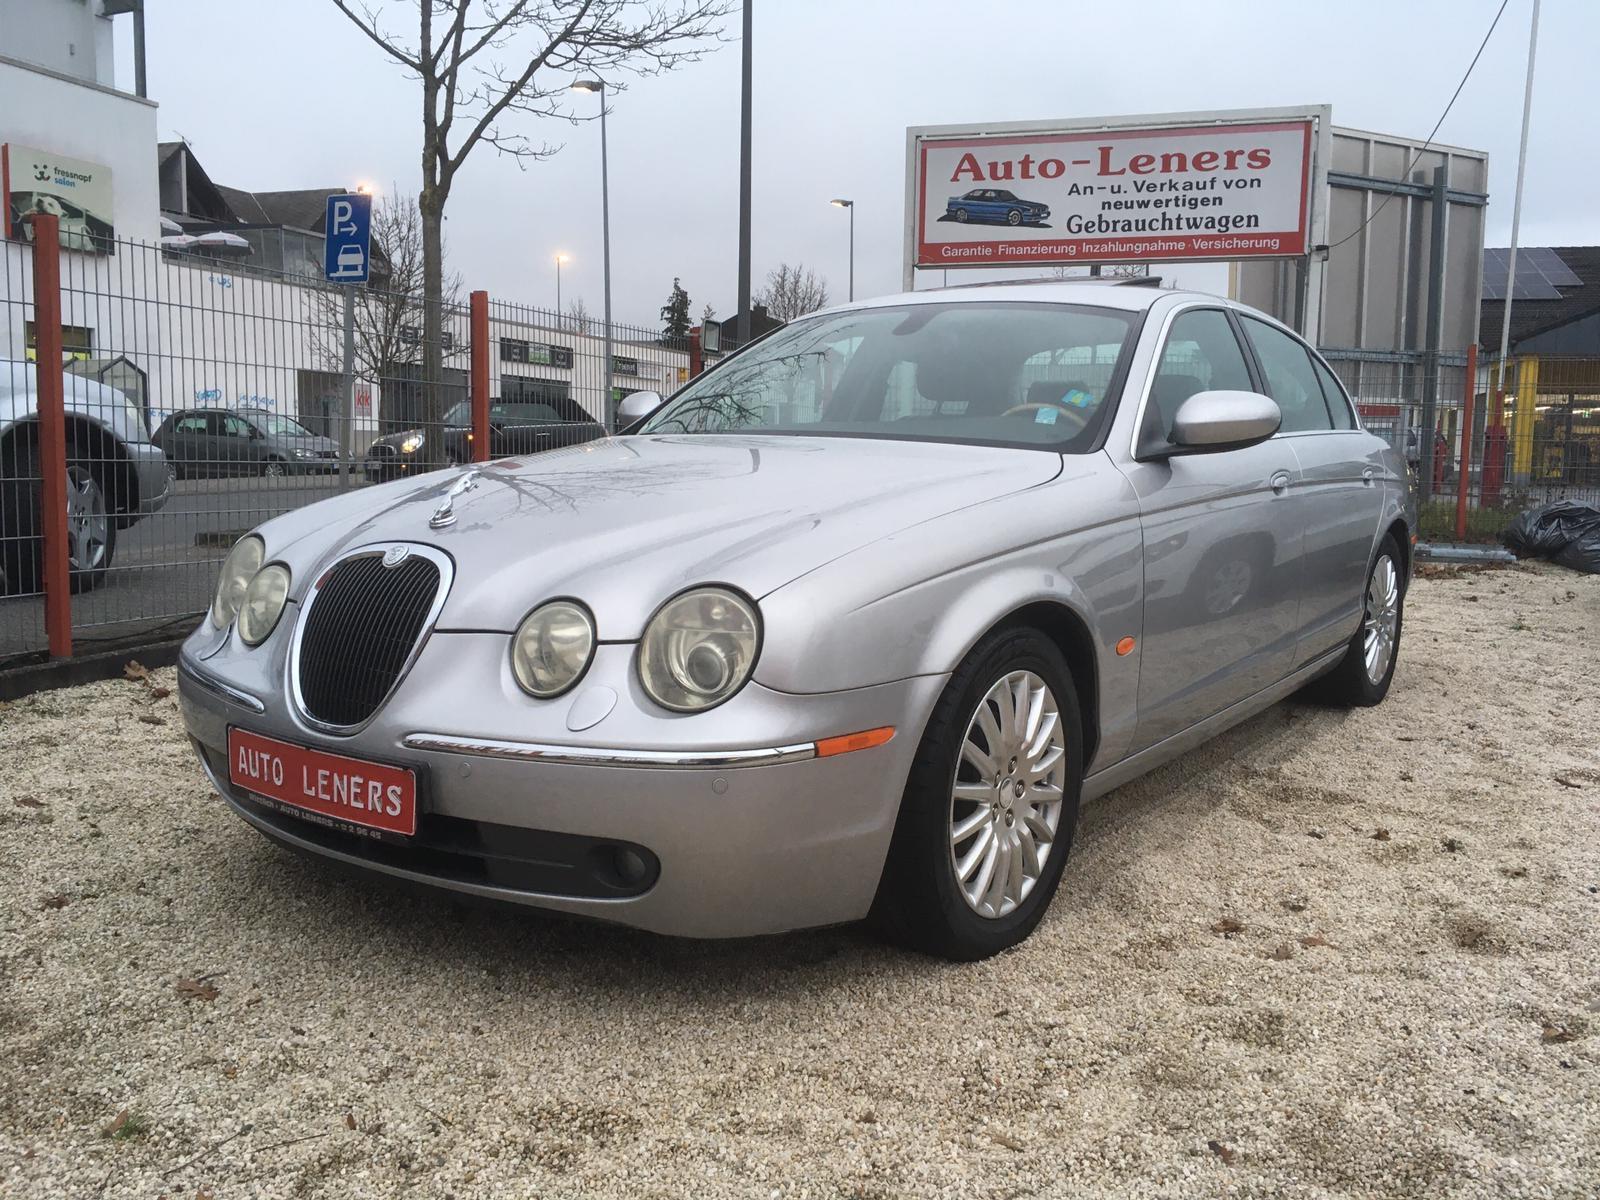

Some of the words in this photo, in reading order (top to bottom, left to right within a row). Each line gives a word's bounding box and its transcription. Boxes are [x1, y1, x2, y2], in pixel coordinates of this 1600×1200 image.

[949, 145, 1272, 182] Auto-Leners
[53, 166, 92, 183] fressnapf
[54, 177, 76, 187] salon
[1132, 177, 1217, 193] Verkauf
[1223, 177, 1262, 190] von
[1101, 194, 1223, 210] neuwertigen
[333, 201, 352, 235] P
[1066, 212, 1260, 234] Gebrauchtwagen
[941, 245, 992, 257] Garantie
[998, 244, 1077, 256] Finanzierung
[1082, 240, 1186, 254] Inzahlungnahme
[1192, 238, 1280, 250] Versicherung
[238, 745, 284, 786] AUTO
[303, 765, 403, 817] LENERS
[280, 805, 300, 817] AUTO
